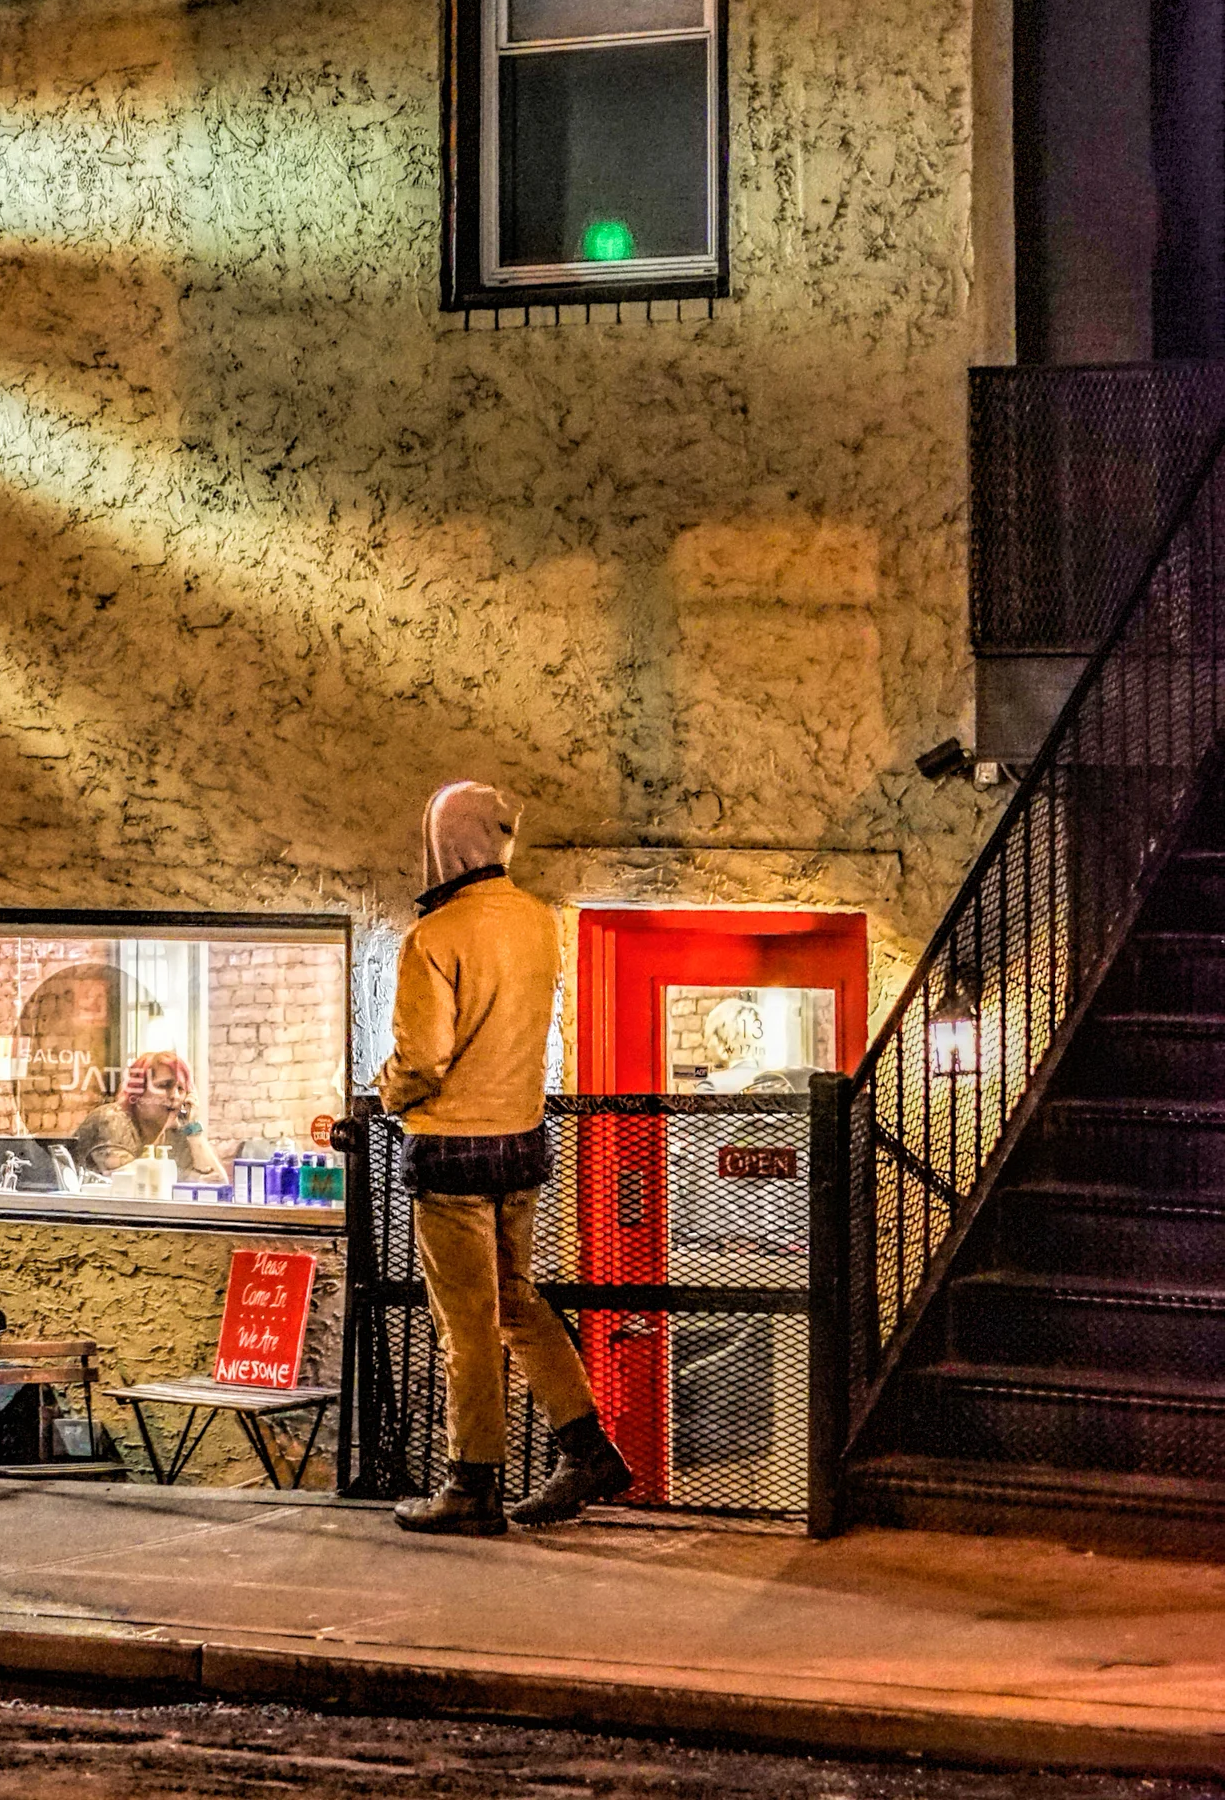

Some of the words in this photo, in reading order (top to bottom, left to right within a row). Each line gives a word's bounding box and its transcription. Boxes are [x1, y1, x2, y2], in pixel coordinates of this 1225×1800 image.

[742, 1018, 764, 1040] 13
[20, 1048, 92, 1065] SALON
[60, 1052, 166, 1095] JATEL
[726, 1152, 789, 1175] OPEN
[251, 1252, 288, 1277] Please
[241, 1283, 271, 1308] Come
[269, 1285, 288, 1308] In
[238, 1324, 258, 1349] We
[256, 1326, 279, 1354] Are
[216, 1358, 290, 1387] AWESOME
